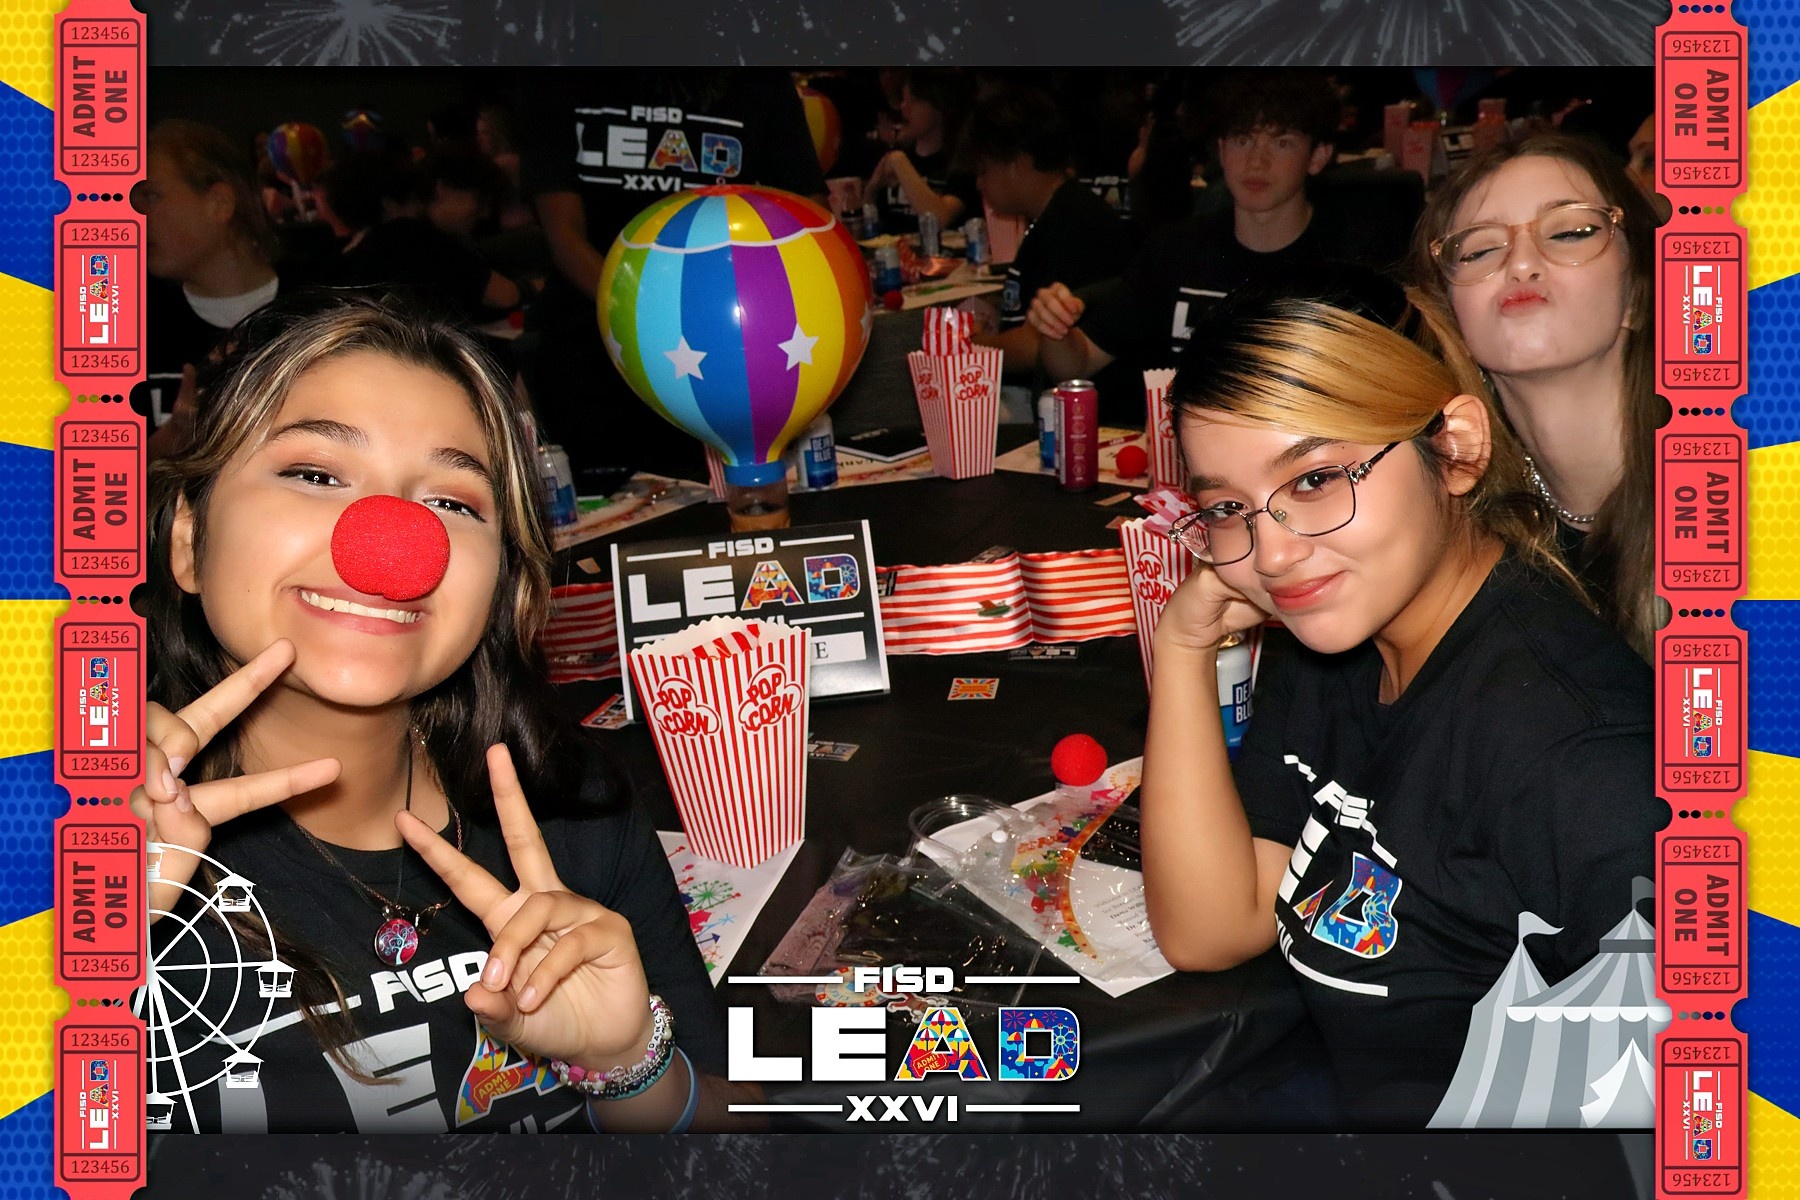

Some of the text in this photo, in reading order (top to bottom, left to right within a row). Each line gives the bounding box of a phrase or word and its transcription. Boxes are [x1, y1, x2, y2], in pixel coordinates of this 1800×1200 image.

[631, 104, 683, 125] FISD
[575, 121, 743, 178] LEAD
[623, 173, 682, 193] XXVI
[960, 370, 982, 386] POP
[958, 383, 990, 401] CORN
[708, 537, 775, 560] FISD
[1137, 560, 1162, 580] POP
[628, 553, 861, 624] LEAD
[657, 687, 692, 712] POP
[746, 672, 782, 706] POP
[664, 710, 709, 736] CORN
[744, 693, 794, 732] CORN
